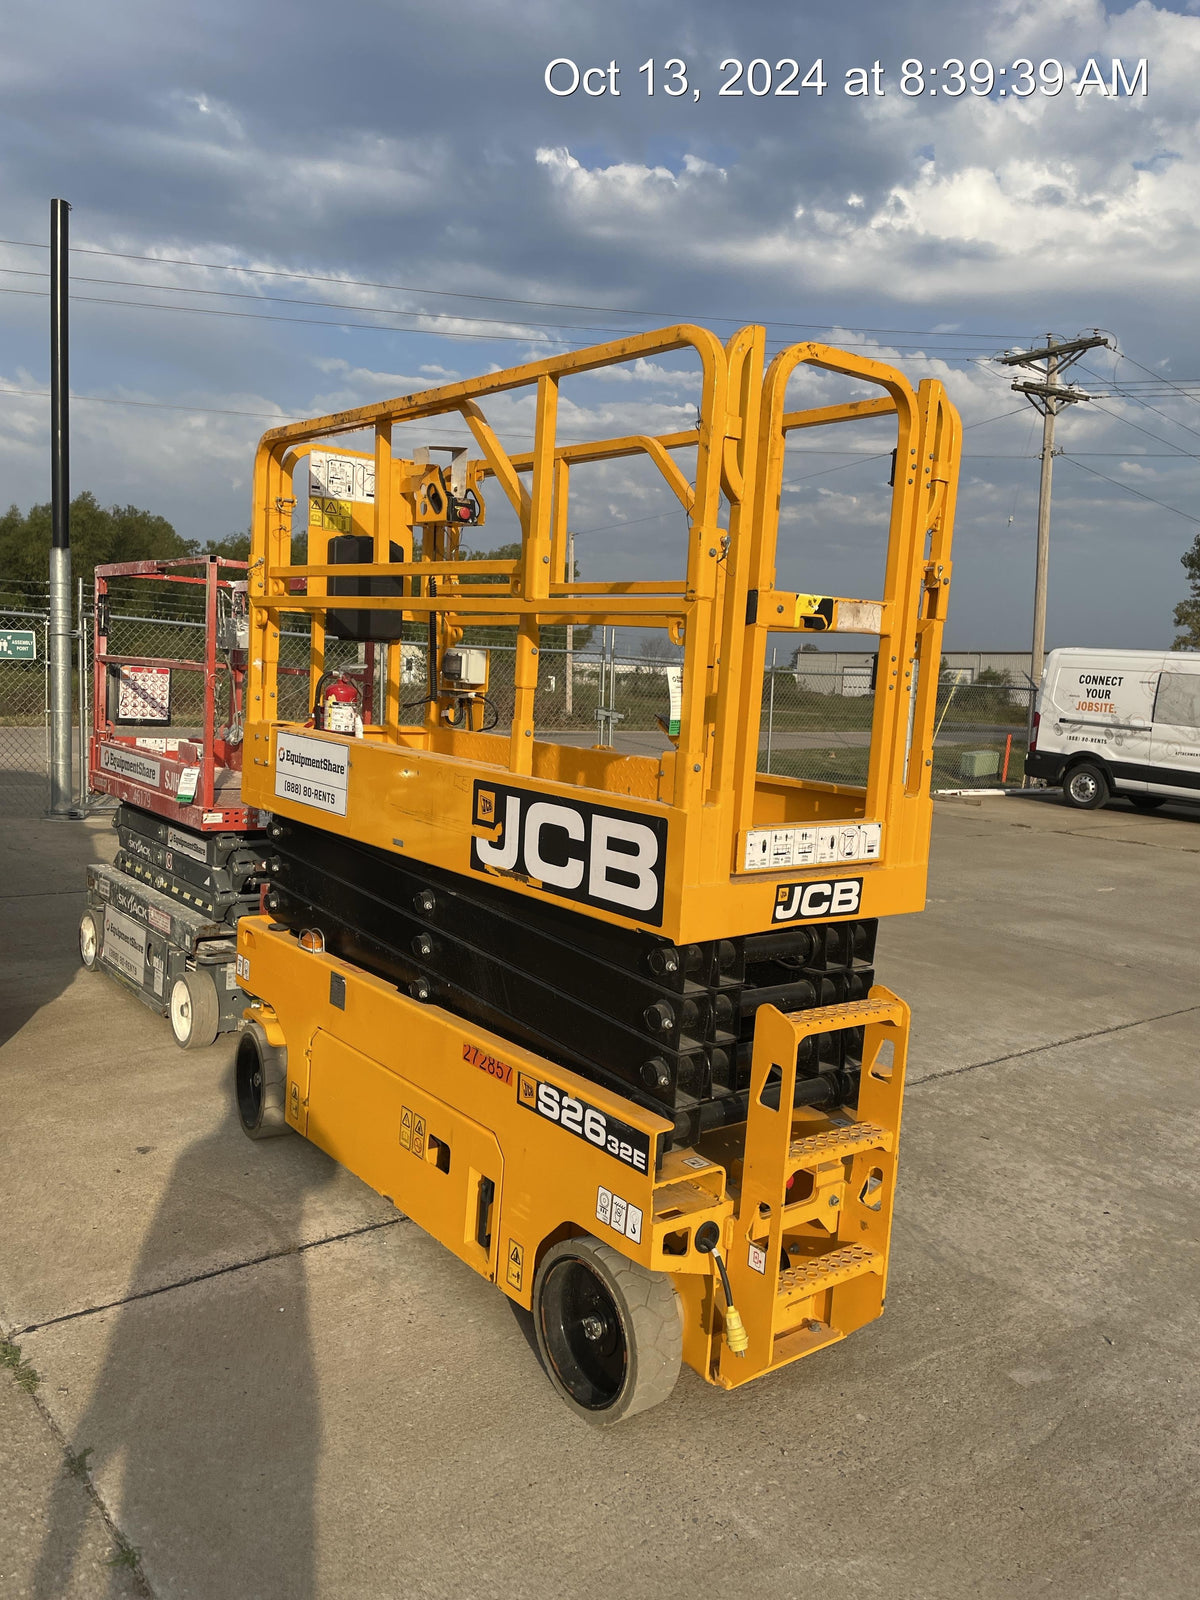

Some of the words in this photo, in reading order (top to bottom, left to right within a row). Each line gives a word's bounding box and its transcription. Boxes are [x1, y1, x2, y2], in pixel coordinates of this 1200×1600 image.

[1079, 674, 1124, 687] CONNECT
[1086, 688, 1111, 700] YOUR
[1075, 701, 1117, 714] JOBSITE.
[109, 752, 156, 780] EquipmentShare
[286, 750, 345, 775] EquipmentShare
[284, 780, 301, 796] (888)
[303, 786, 335, 805] 80-RENTS
[476, 795, 658, 911] JCB
[117, 893, 148, 920] SKYJACK
[775, 881, 860, 920] JCB
[463, 1044, 513, 1083] 272857
